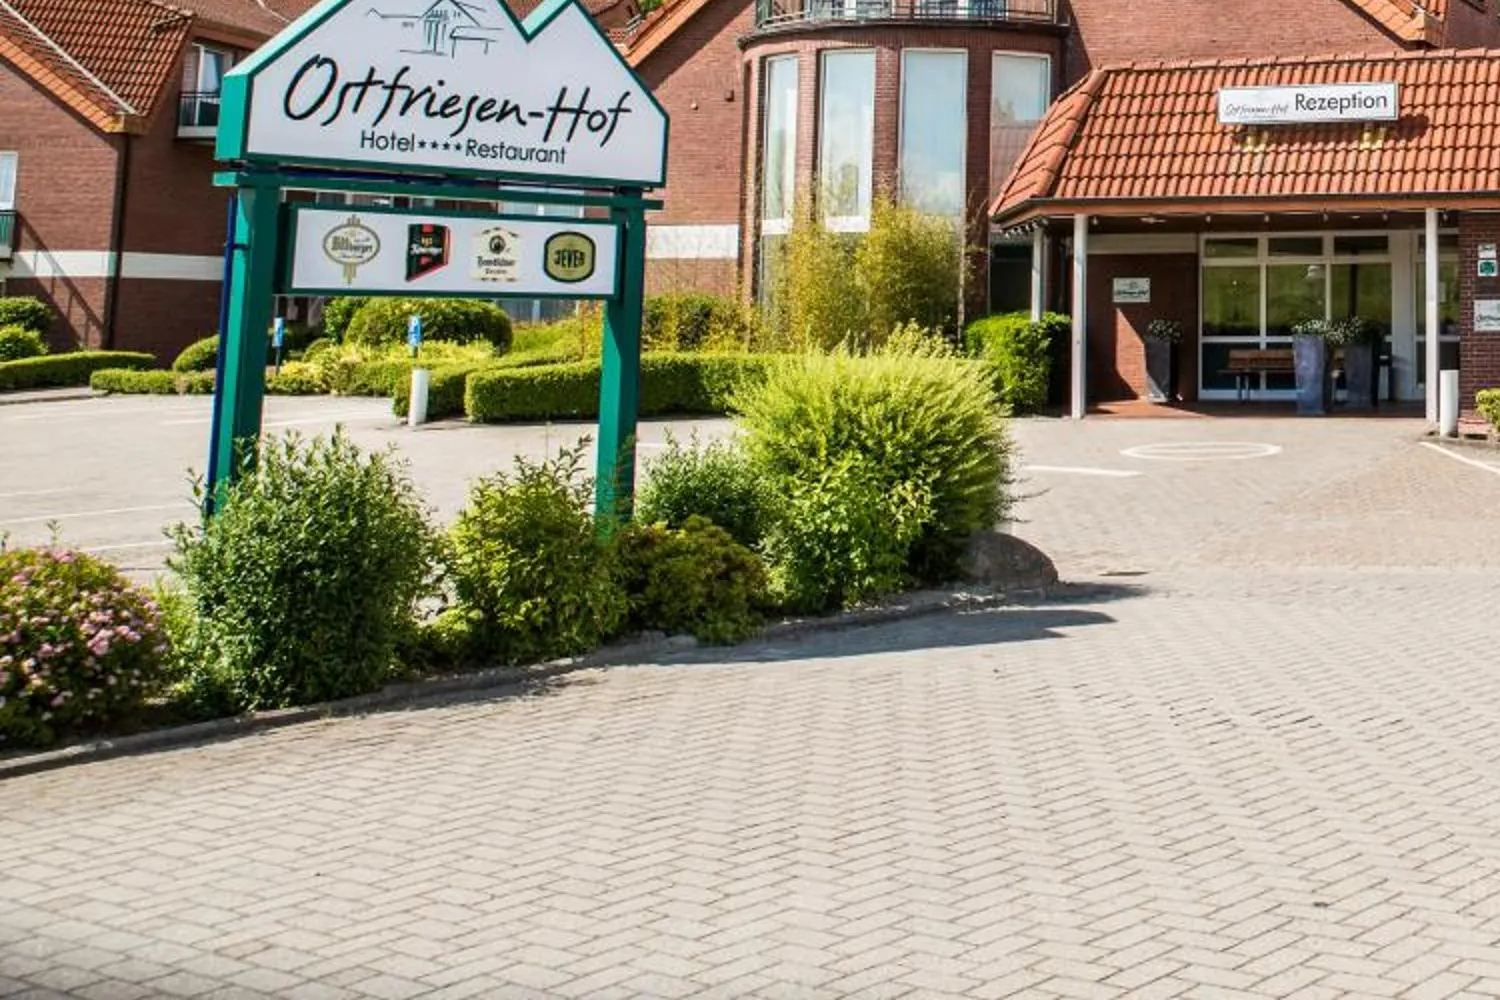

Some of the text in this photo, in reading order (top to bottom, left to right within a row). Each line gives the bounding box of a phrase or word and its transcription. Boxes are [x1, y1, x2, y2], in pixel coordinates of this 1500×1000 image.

[284, 53, 632, 148] Ostfriesen-Hof
[1294, 91, 1388, 114] Rezeption
[360, 130, 567, 164] Hotel Restaurant
[553, 248, 585, 269] JEVER
